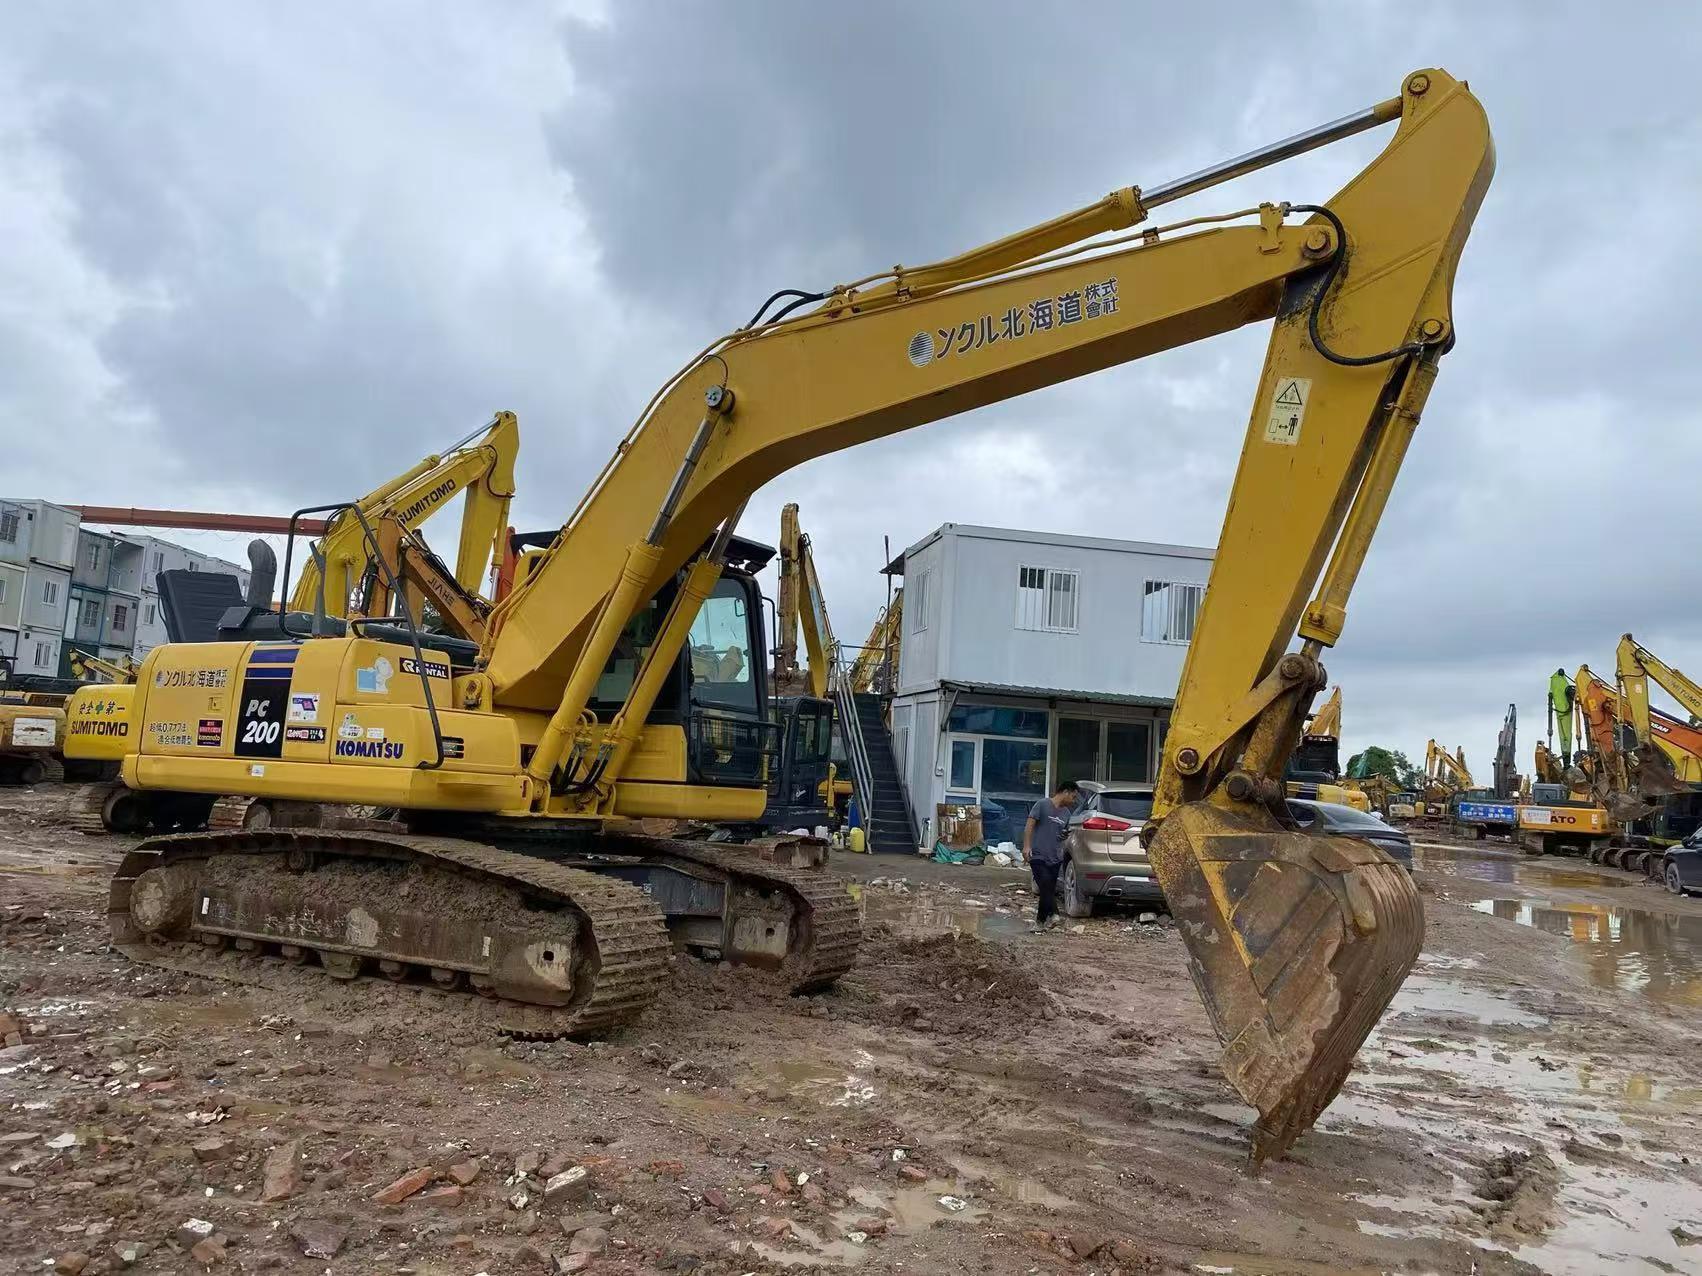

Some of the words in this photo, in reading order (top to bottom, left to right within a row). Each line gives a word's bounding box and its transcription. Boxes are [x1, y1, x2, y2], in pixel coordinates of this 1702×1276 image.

[1085, 278, 1118, 301] 株式
[397, 478, 456, 526] SUMITOMO
[415, 666, 447, 678] RNTAL
[246, 699, 270, 717] PC
[70, 720, 129, 737] SUMITOMO
[242, 720, 280, 744] 200
[335, 738, 404, 760] KOMATSU
[1551, 815, 1577, 825] ATO
